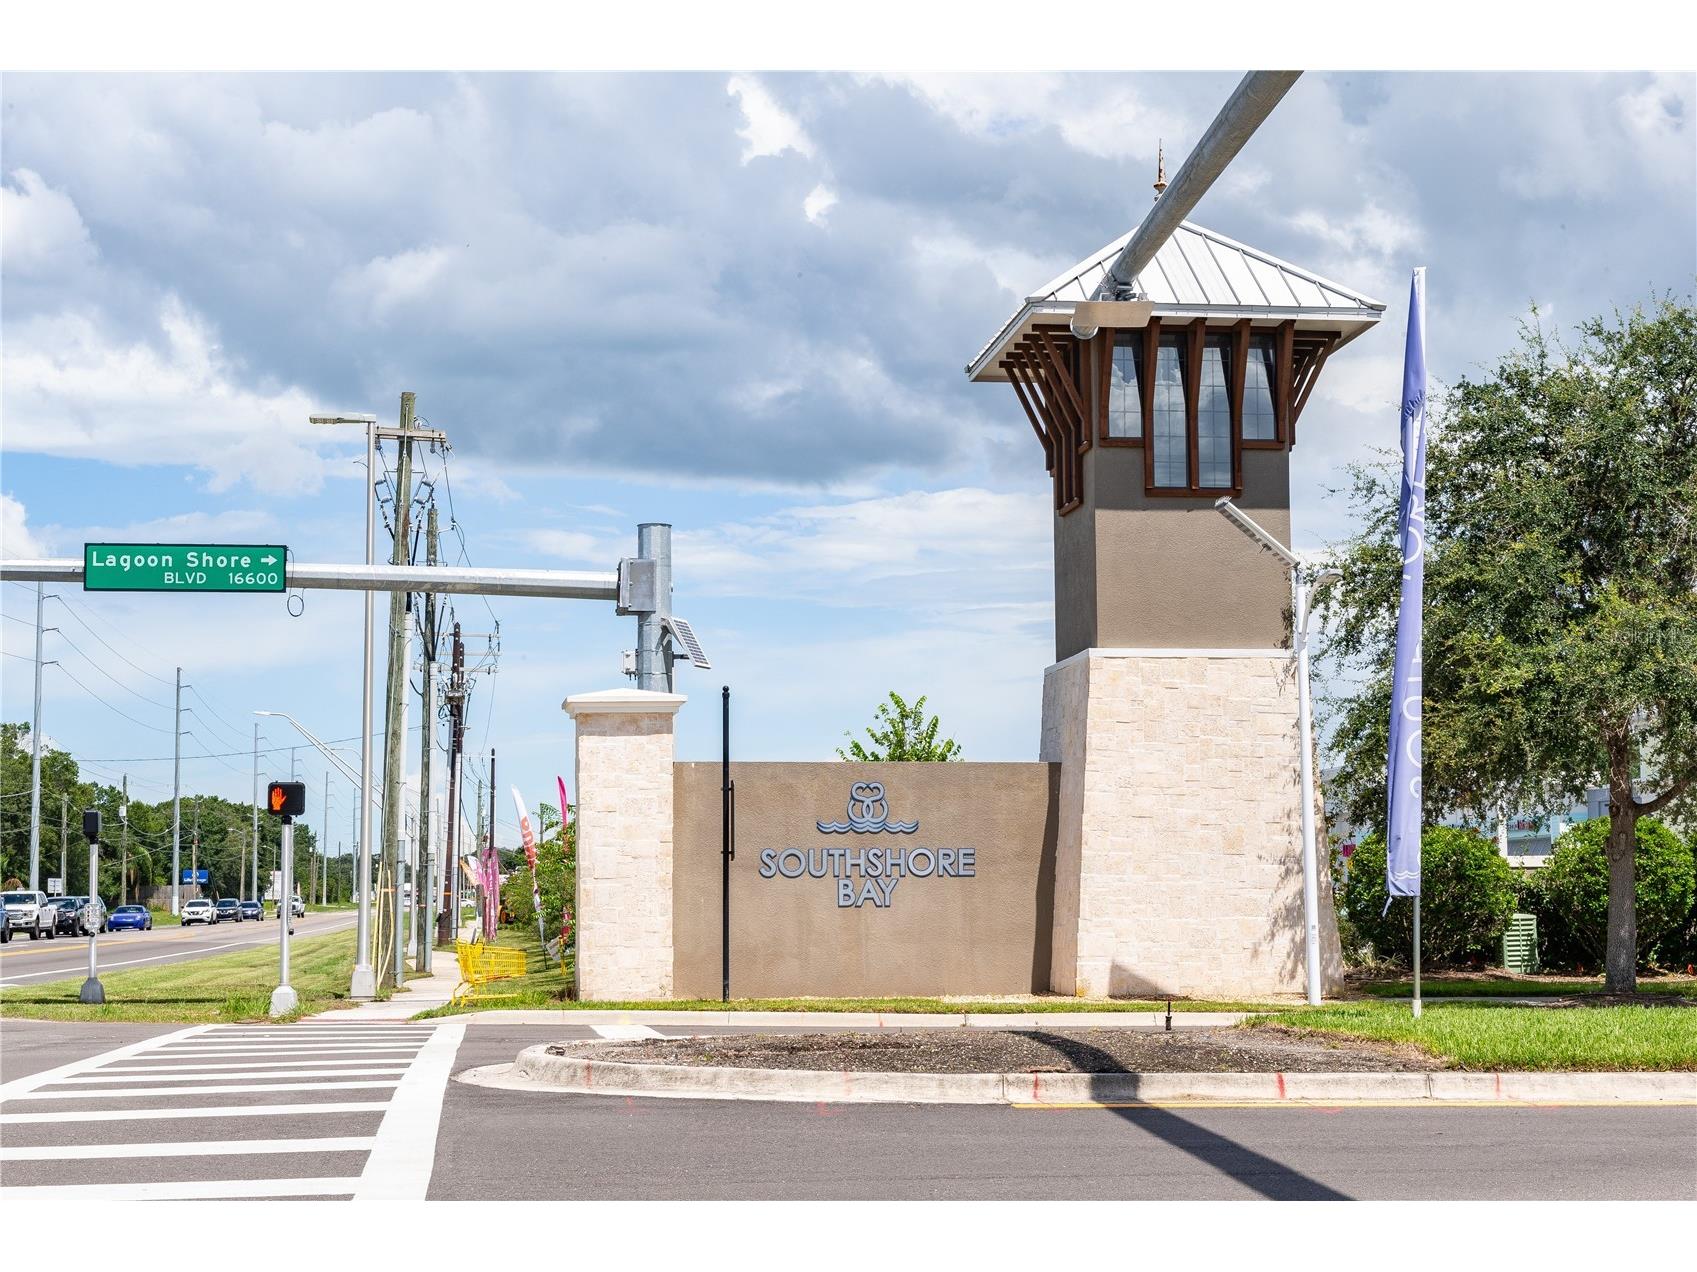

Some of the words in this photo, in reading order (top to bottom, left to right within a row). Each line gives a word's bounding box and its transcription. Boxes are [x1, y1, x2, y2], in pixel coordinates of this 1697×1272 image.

[92, 551, 173, 572] Lagoon
[186, 551, 251, 568] Shore
[164, 572, 207, 584] BLVD
[228, 572, 278, 585] 16600
[758, 848, 976, 878] SOUTHSHORE
[837, 878, 898, 908] BAY
